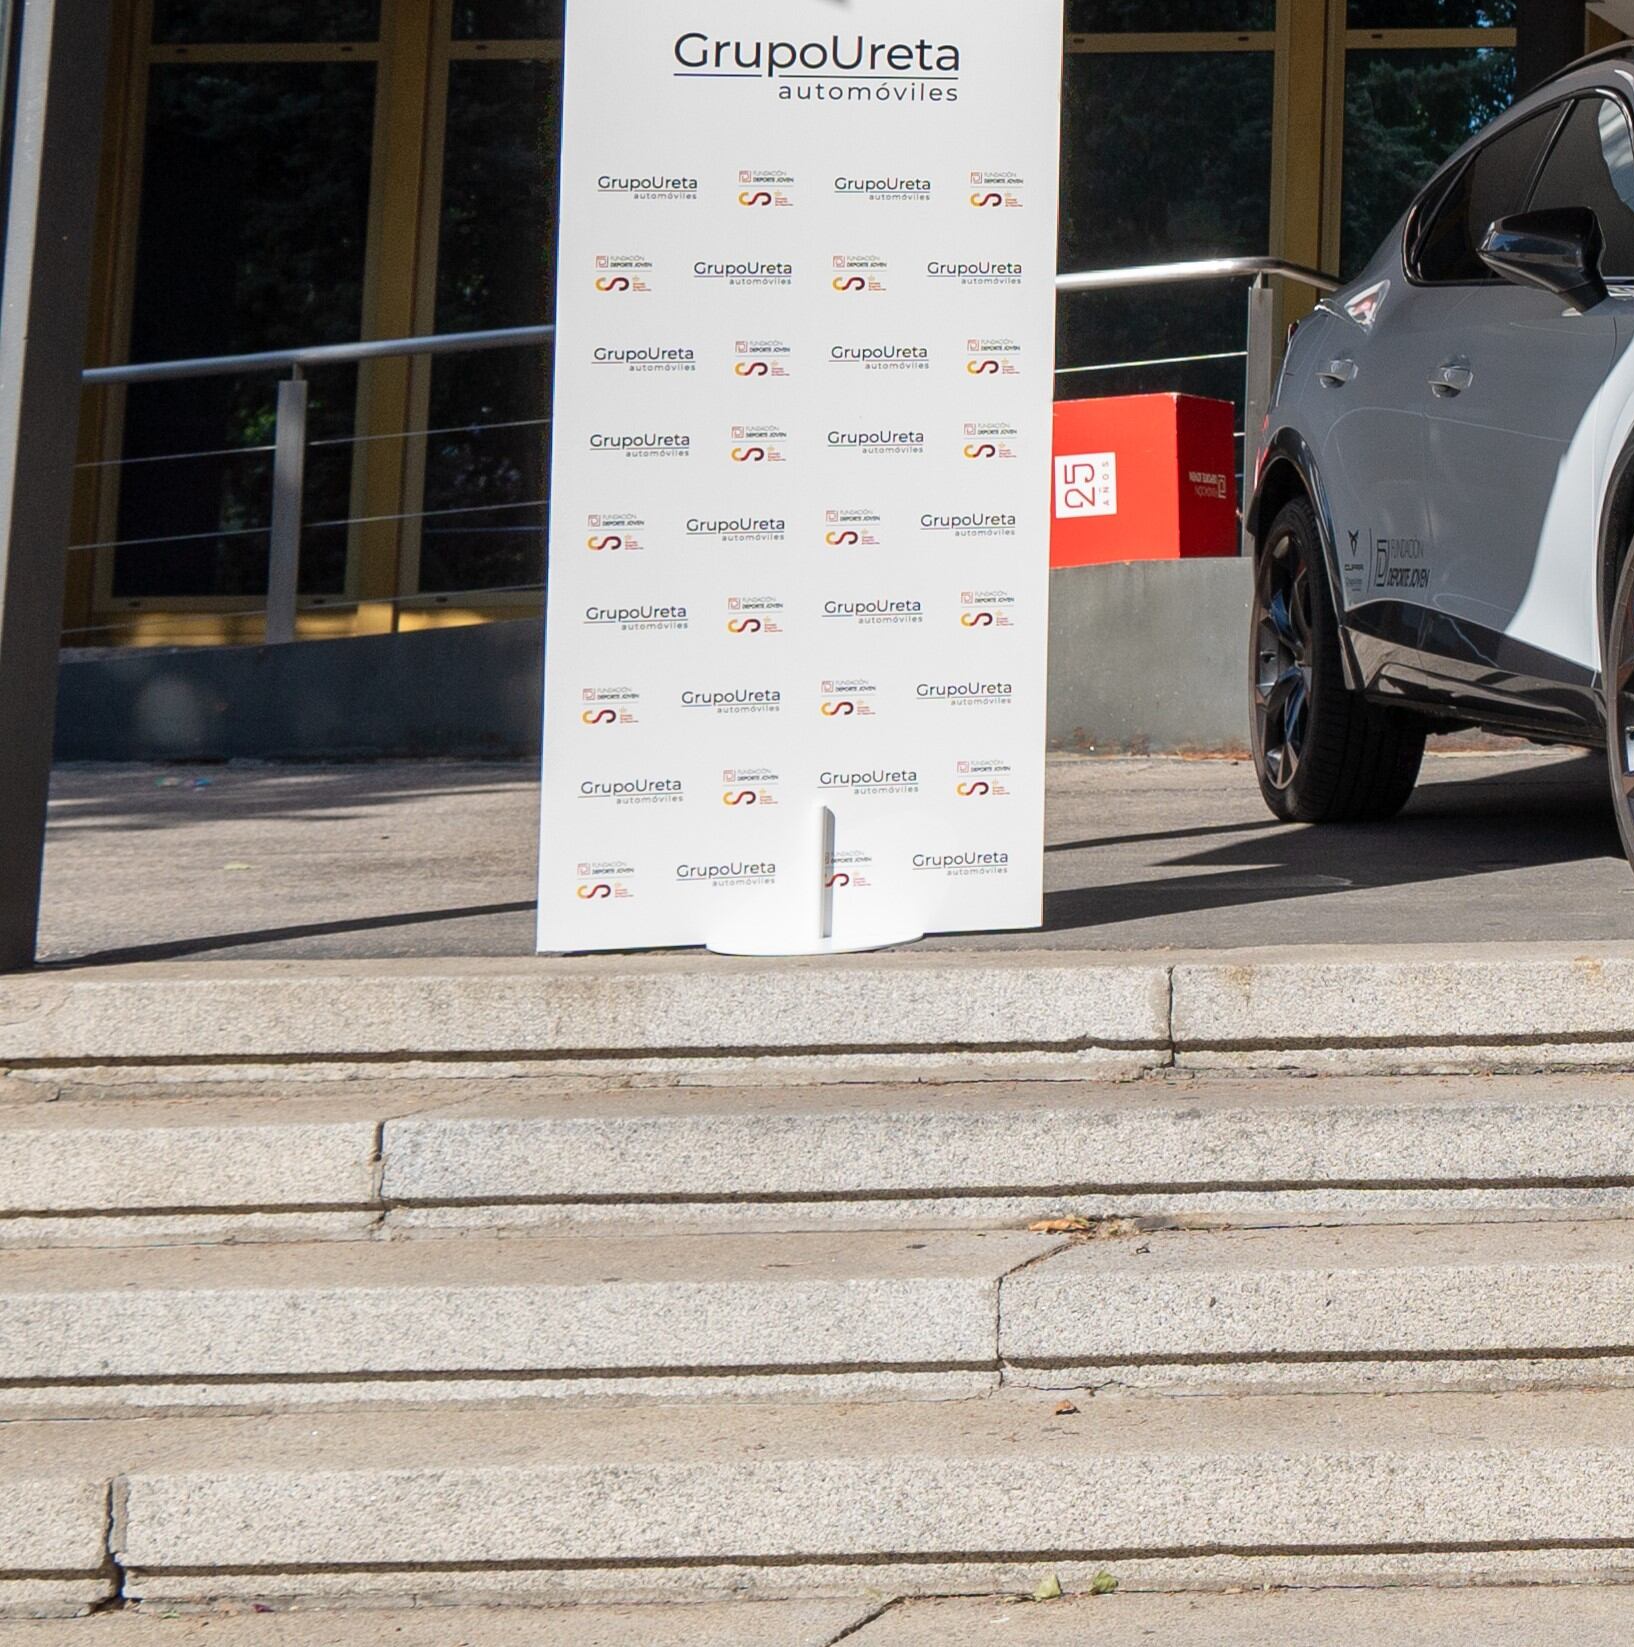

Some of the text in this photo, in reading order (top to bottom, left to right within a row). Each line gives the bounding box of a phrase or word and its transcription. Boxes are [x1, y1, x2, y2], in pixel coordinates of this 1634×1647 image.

[674, 32, 960, 77] GrupoUreta
[778, 82, 958, 102] automóviles
[598, 176, 697, 191] GrupoUreta
[834, 177, 930, 192] GrupoUreta
[634, 191, 696, 200] automóviles
[869, 192, 930, 201] automóviles
[694, 262, 792, 277] GrupoUreta
[927, 262, 1022, 277] GrupoUreta
[594, 347, 694, 363] GrupoUreta
[831, 346, 928, 361] GrupoUreta
[629, 363, 696, 372] automóviles
[590, 433, 690, 449] GrupoUreta
[827, 431, 924, 446] GrupoUreta
[626, 449, 689, 457] automóviles
[1064, 463, 1094, 508] 25
[1099, 461, 1110, 506] AÑOS
[686, 518, 784, 534] GrupoUreta
[920, 514, 1015, 528] GrupoUreta
[586, 606, 686, 622] GrupoUreta
[824, 600, 921, 616] GrupoUreta
[621, 622, 688, 631] automóviles
[859, 616, 923, 624] automóviles
[681, 690, 780, 705] GrupoUreta
[916, 682, 1012, 698] GrupoUreta
[820, 770, 917, 785] GrupoUreta
[581, 780, 681, 795] GrupoUreta
[854, 786, 919, 794] automóviles
[616, 796, 683, 804] automóviles
[913, 853, 1008, 868] GrupoUreta
[677, 862, 776, 878] GrupoUreta
[947, 867, 1008, 876] automóviles
[712, 878, 775, 887] automóviles
